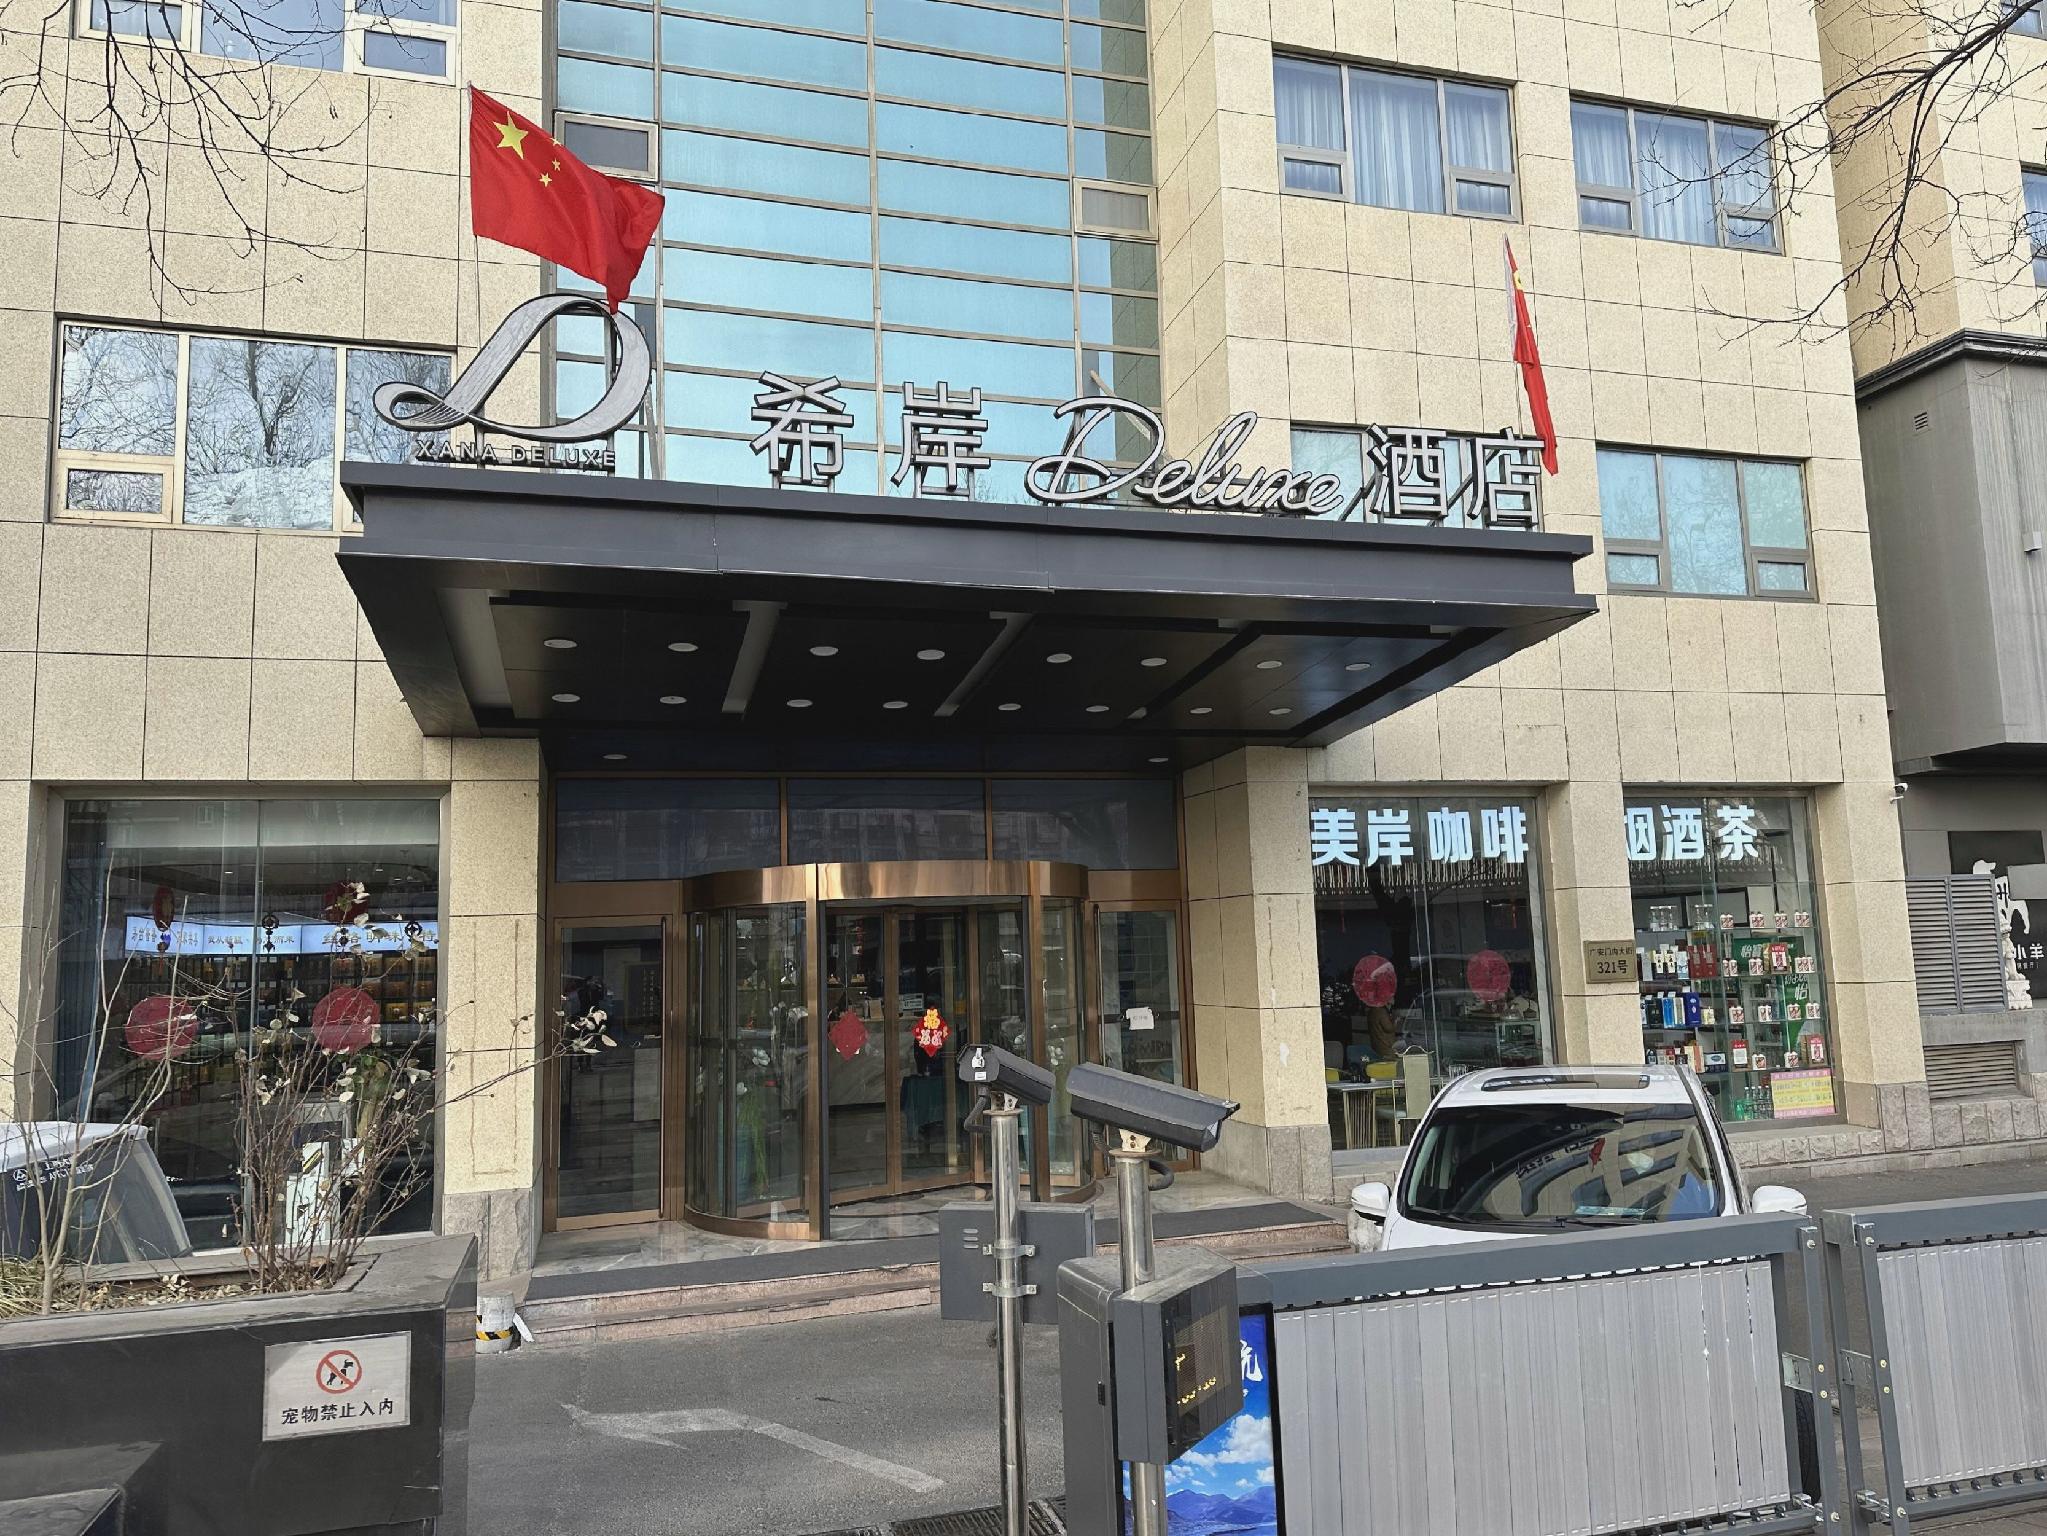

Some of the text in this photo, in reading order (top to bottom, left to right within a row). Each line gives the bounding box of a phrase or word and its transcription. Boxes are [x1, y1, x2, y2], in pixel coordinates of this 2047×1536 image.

[417, 440, 615, 467] XANA DELUXE
[750, 371, 1545, 526] 希岸 Deluxe 酒店
[1310, 806, 1529, 867] 美岸咖啡
[1597, 960, 1628, 974] 321号
[281, 1397, 393, 1425] 宠物禁止入内
